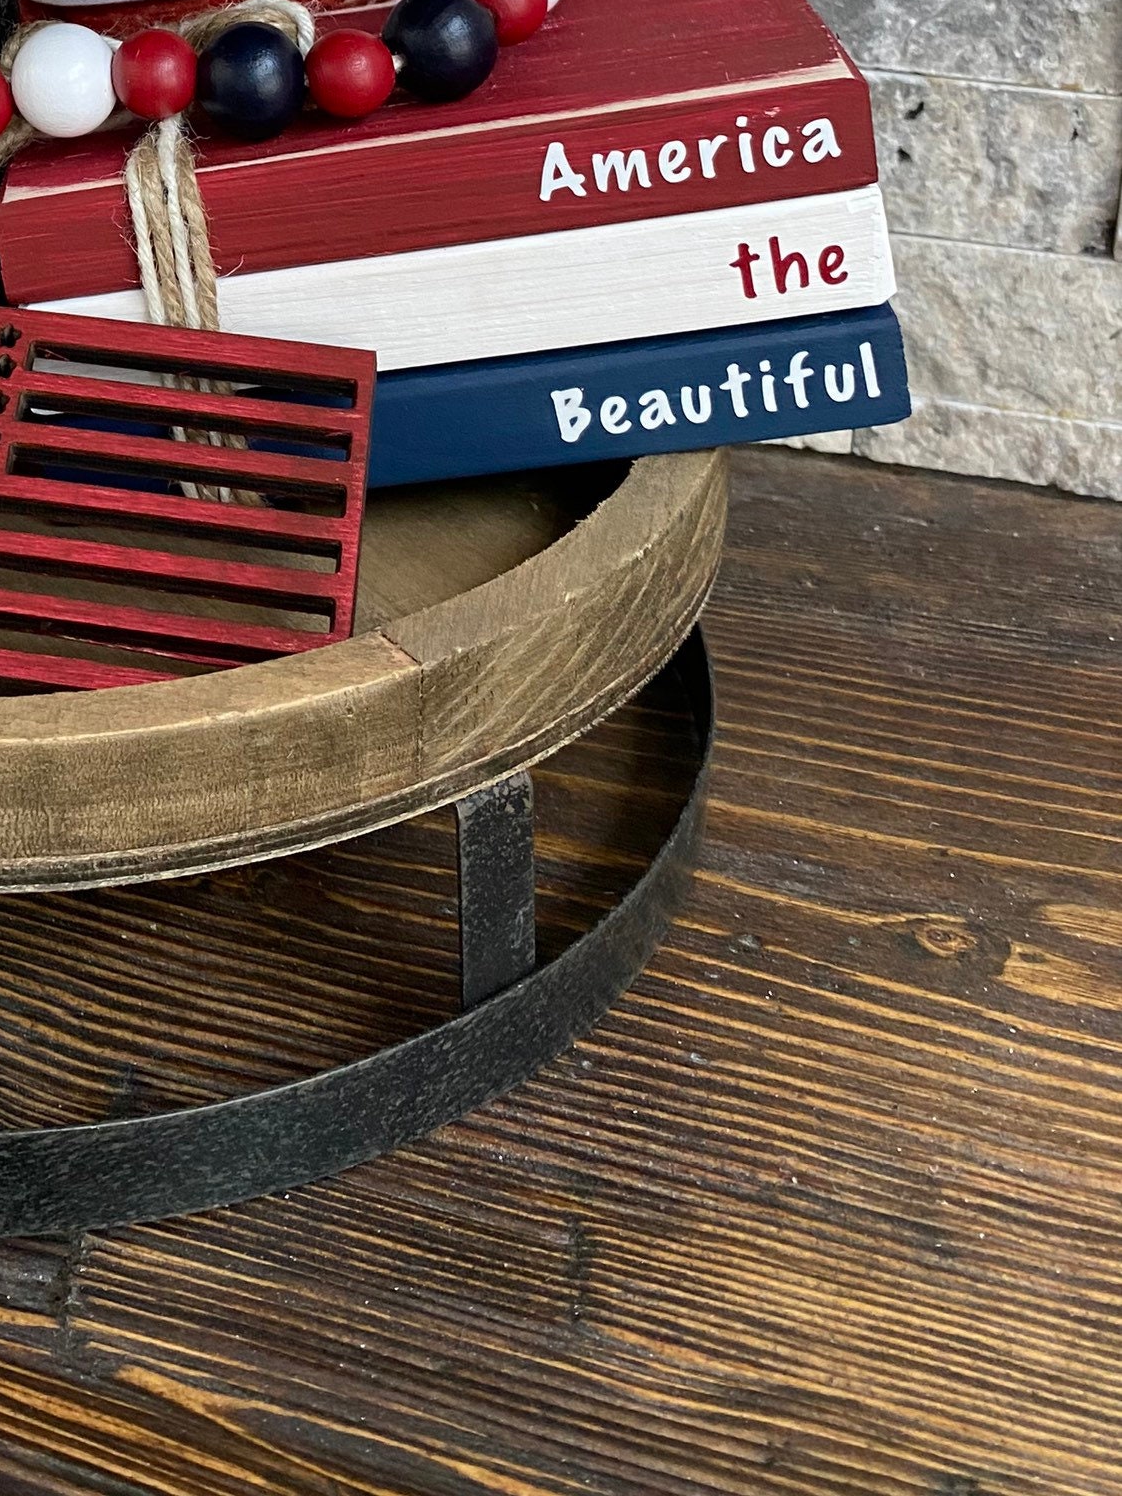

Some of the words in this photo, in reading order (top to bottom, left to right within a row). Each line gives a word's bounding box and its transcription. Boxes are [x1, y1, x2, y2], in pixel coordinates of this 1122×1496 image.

[539, 115, 842, 202] America
[728, 236, 849, 299] the
[550, 341, 881, 443] Beautiful
